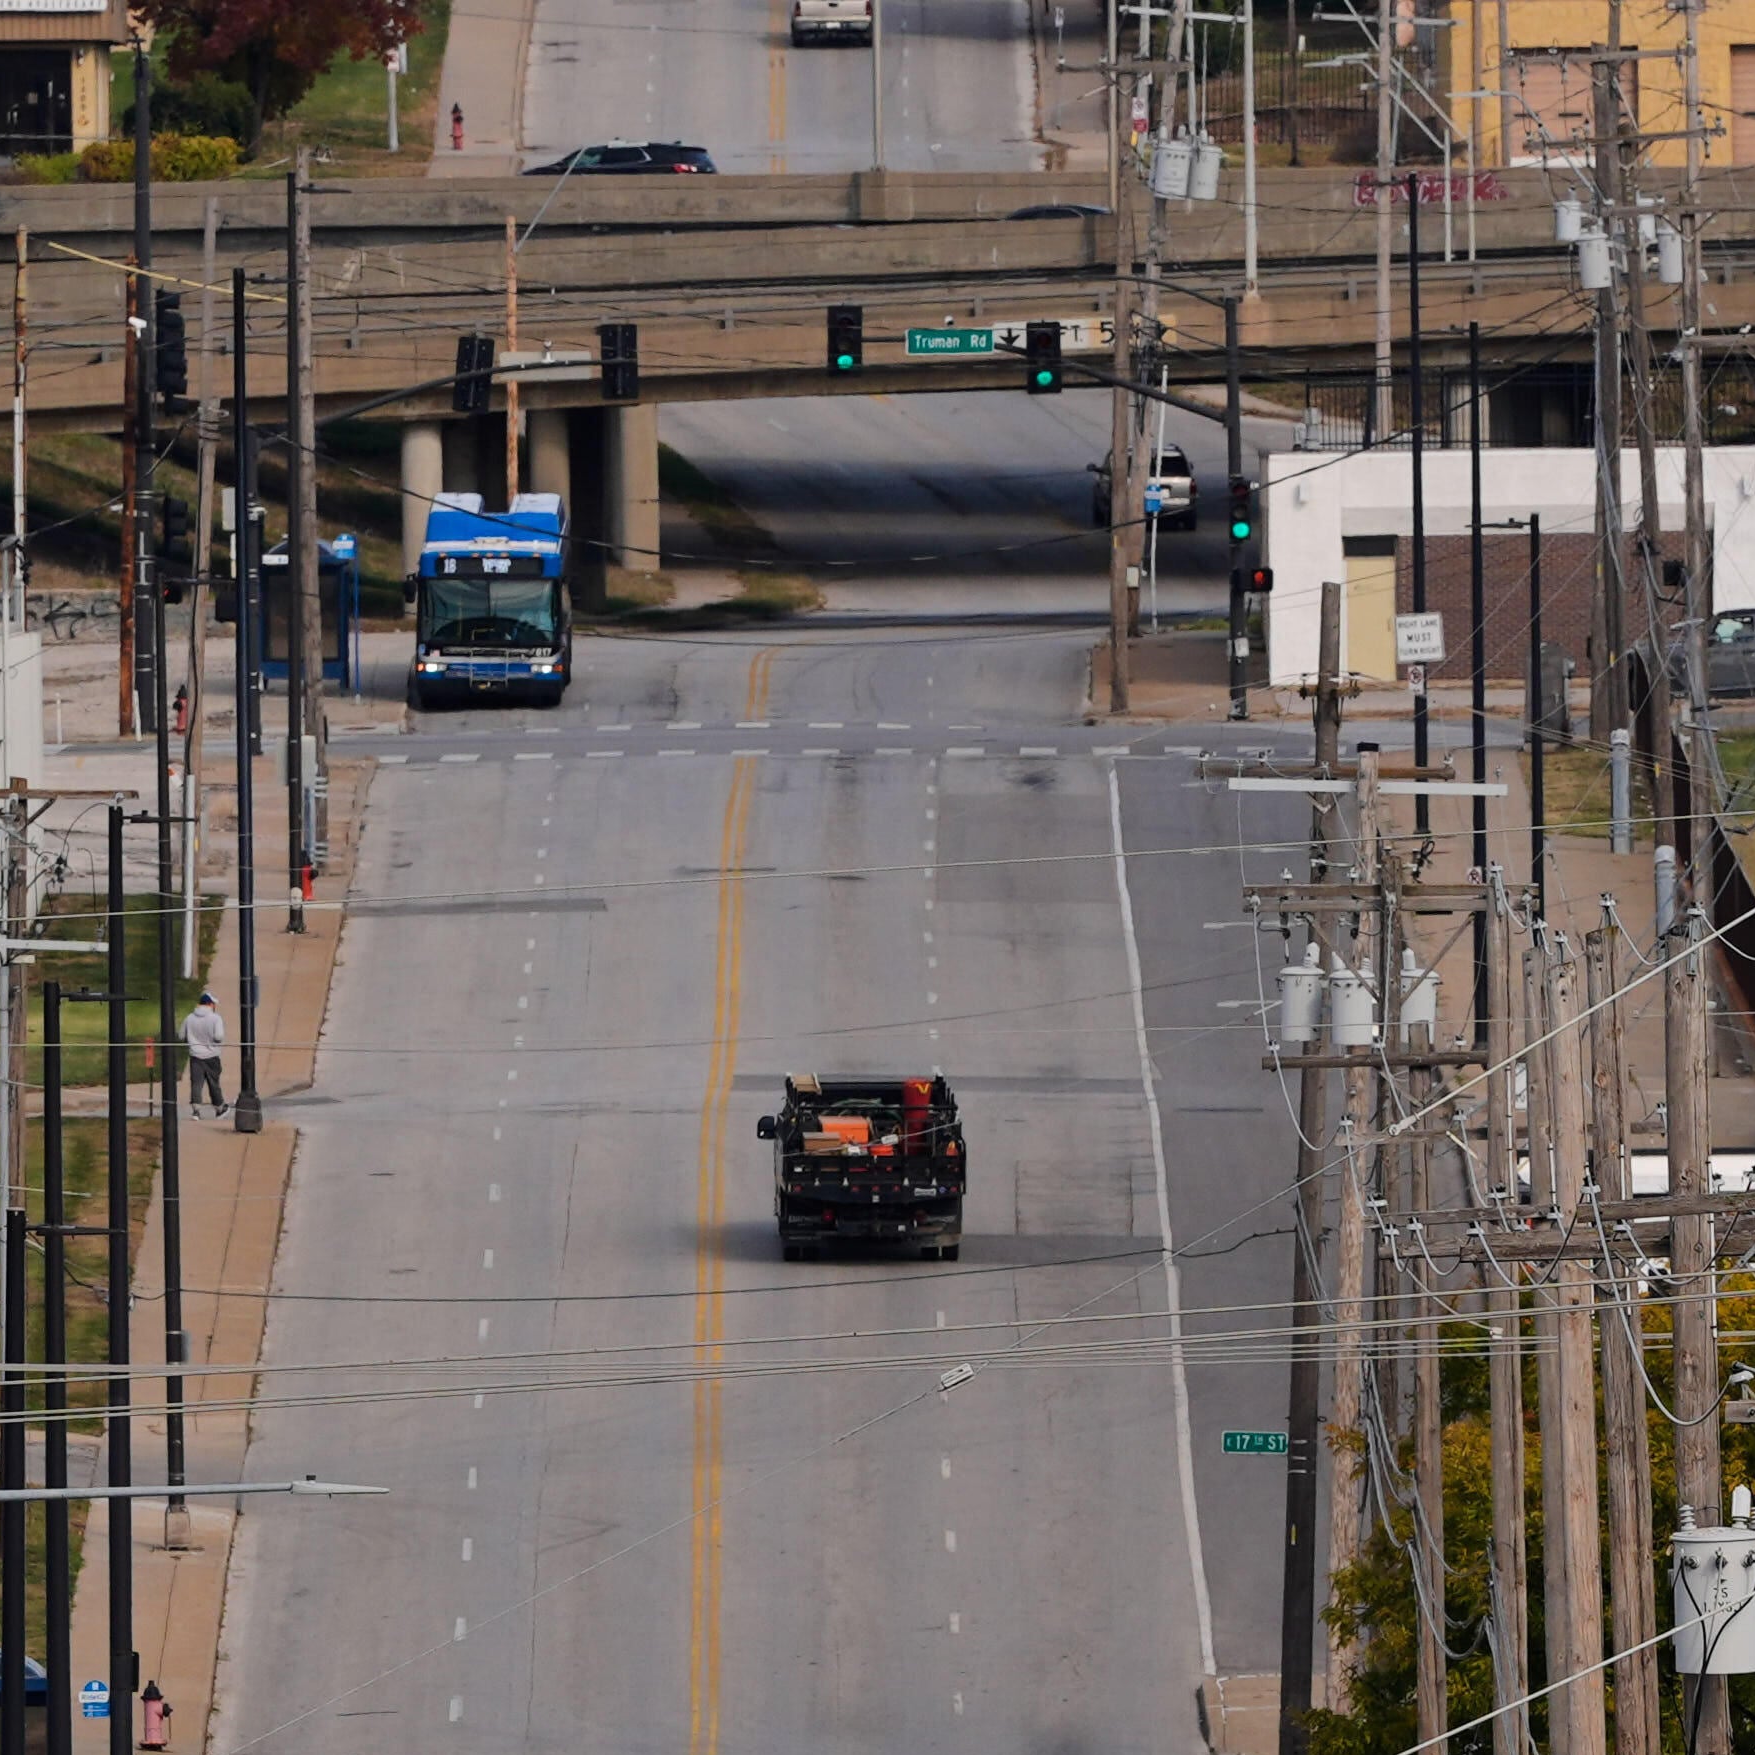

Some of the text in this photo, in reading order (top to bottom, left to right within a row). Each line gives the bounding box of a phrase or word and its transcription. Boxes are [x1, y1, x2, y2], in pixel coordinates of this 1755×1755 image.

[914, 334, 987, 349] Truman Rd
[1407, 631, 1431, 642] MUST
[1268, 1435, 1285, 1451] ST
